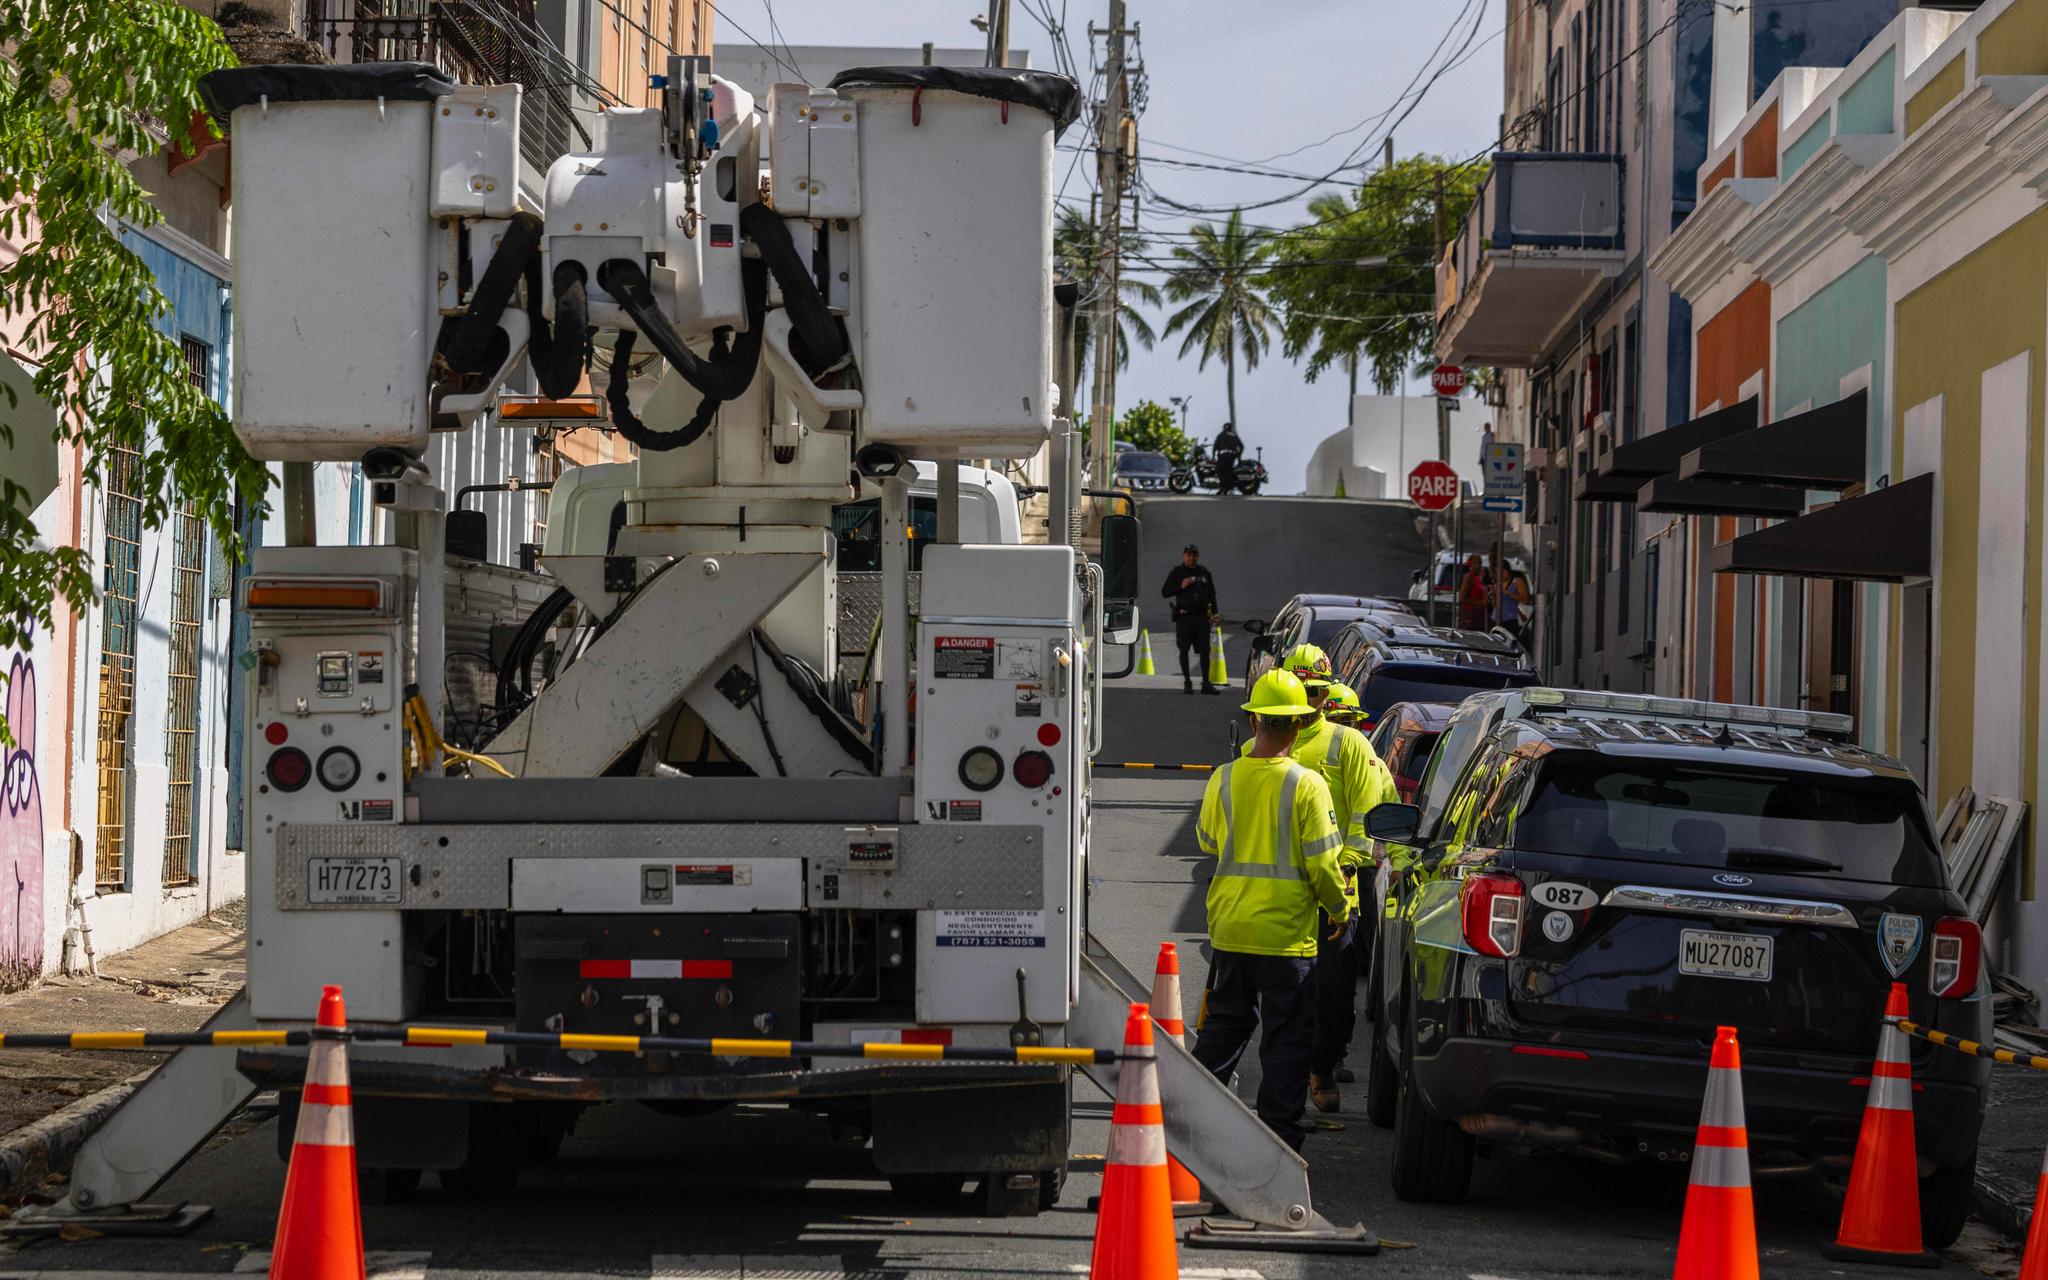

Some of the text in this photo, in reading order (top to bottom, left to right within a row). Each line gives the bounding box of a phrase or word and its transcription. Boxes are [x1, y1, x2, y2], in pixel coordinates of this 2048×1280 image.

[1433, 373, 1464, 386] PARE
[1410, 475, 1456, 496] PARE
[951, 639, 988, 647] DANGER
[318, 865, 391, 891] H77273
[1722, 873, 1744, 883] Ford
[1545, 886, 1584, 906] 087
[1650, 895, 1819, 918] EXPLORER
[951, 937, 980, 946] (787)
[1685, 941, 1766, 969] MU27087
